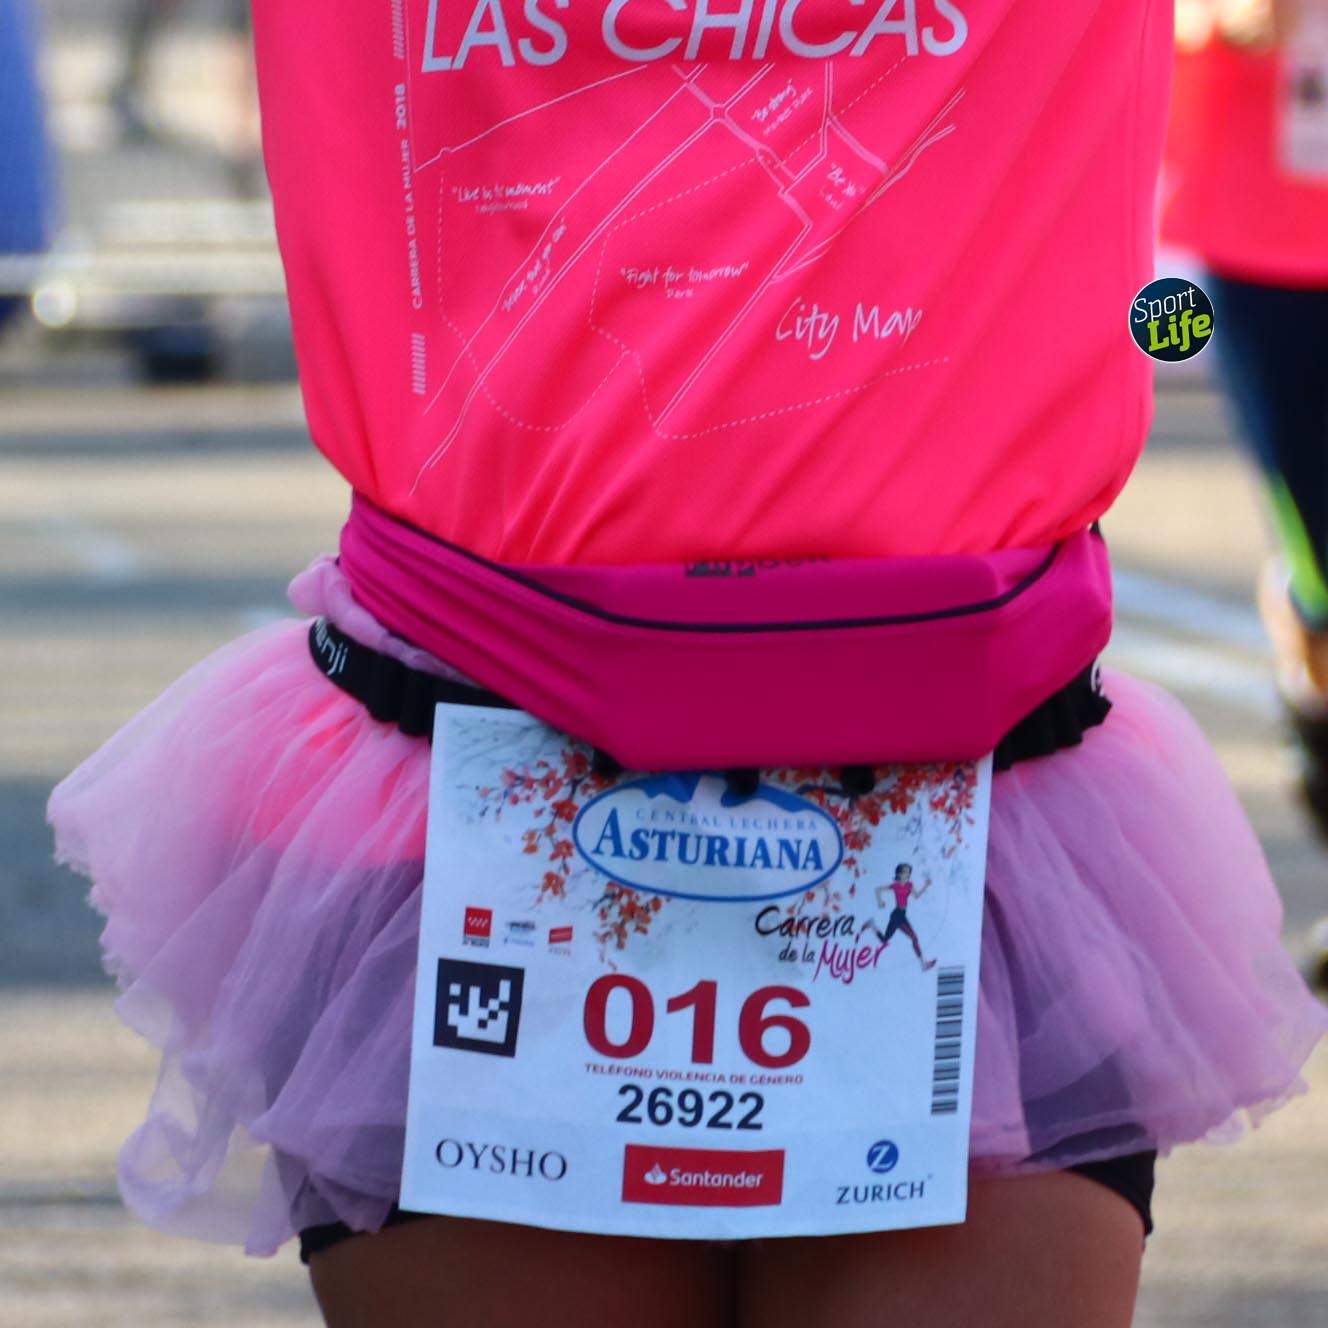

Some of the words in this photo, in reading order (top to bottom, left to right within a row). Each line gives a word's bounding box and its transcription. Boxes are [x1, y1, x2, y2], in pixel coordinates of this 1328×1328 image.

[394, 83, 407, 130] 2018
[404, 192, 413, 212] LA
[405, 215, 416, 235] DE
[408, 239, 423, 309] CARRERA
[775, 295, 840, 360] City
[592, 807, 824, 871] ASTURIANA
[637, 808, 719, 829] CENTRAL
[728, 816, 818, 832] LECHERA
[755, 905, 856, 938] Carrera
[778, 941, 799, 963] de
[801, 942, 815, 963] la
[813, 939, 889, 985] Mujer
[583, 973, 812, 1069] 016
[656, 1069, 726, 1083] VIOLENCIA
[729, 1073, 746, 1084] DE
[615, 1083, 765, 1131] 26922
[435, 1138, 568, 1181] OYSHO
[669, 1166, 765, 1190] Santander
[836, 1180, 925, 1205] ZURICH
